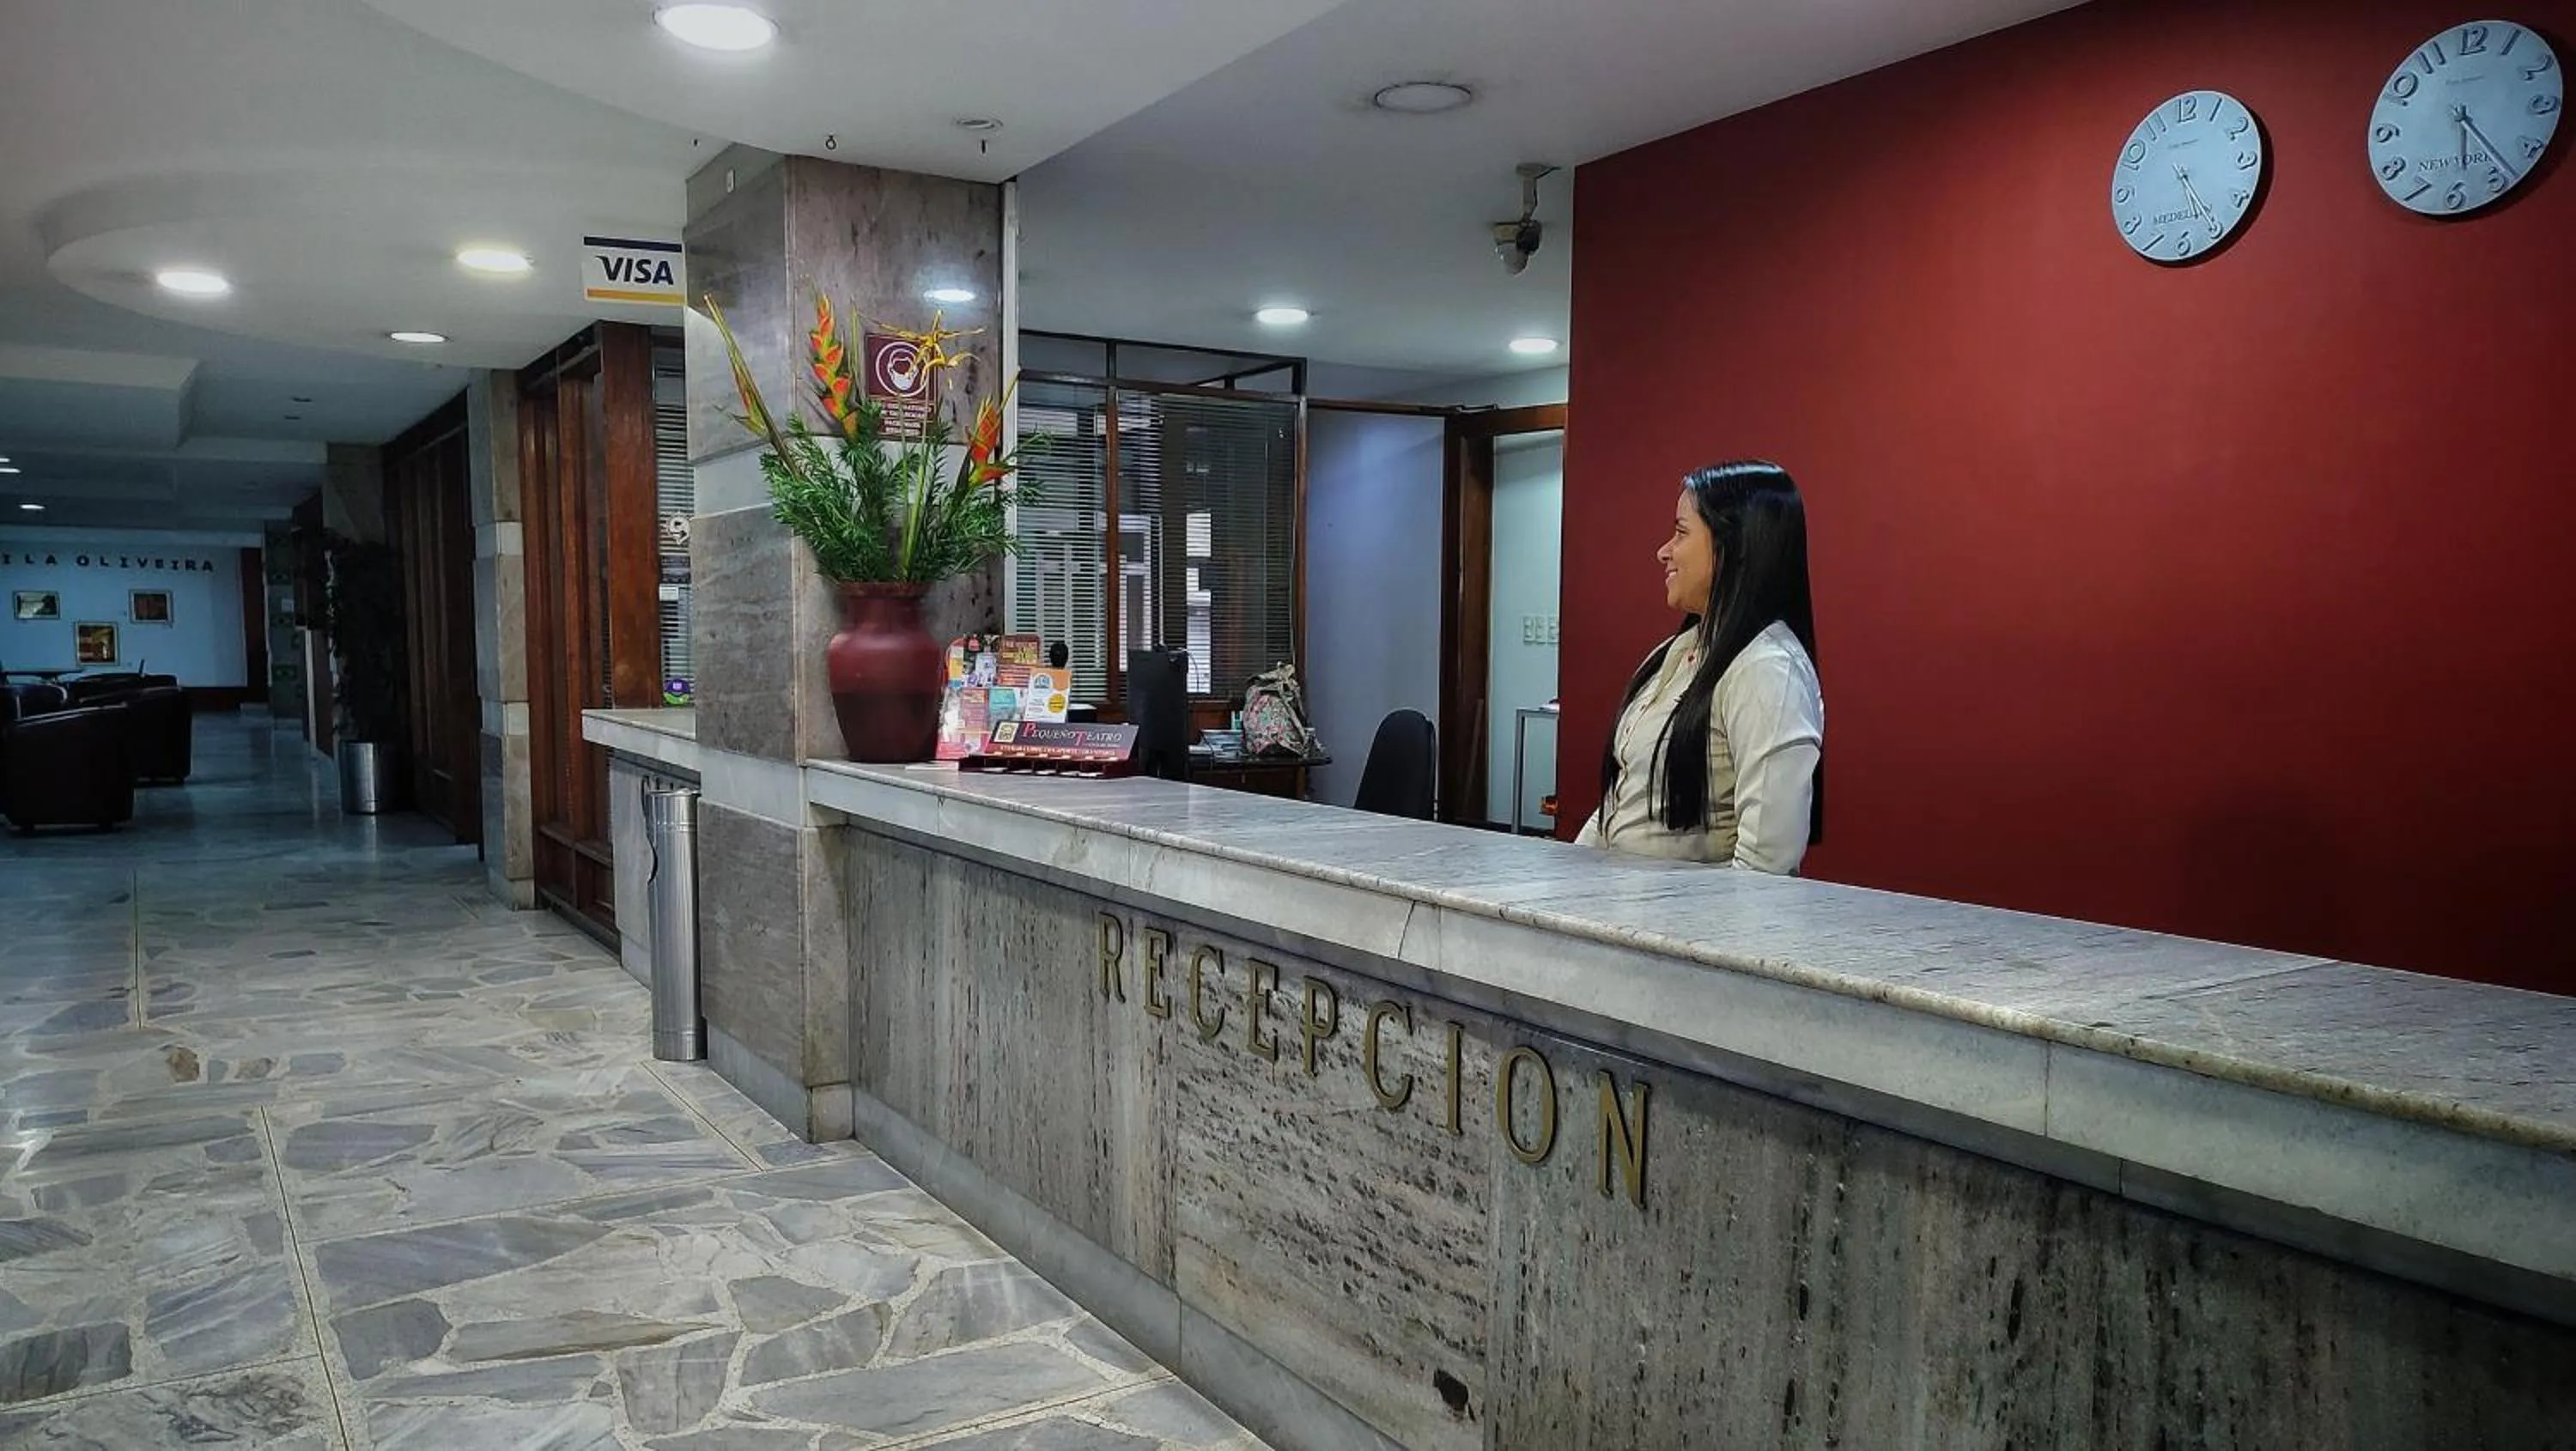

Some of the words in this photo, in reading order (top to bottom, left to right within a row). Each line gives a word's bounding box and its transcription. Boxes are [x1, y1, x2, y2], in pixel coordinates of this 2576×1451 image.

[2459, 26, 2488, 56] 12
[2418, 40, 2446, 74] 11
[2519, 54, 2553, 81] 2
[2386, 71, 2419, 107] 10
[2178, 95, 2197, 123] 12
[2529, 94, 2558, 115] 3
[2147, 112, 2166, 141] 11
[2226, 116, 2249, 141] 2
[2376, 124, 2400, 143] 9
[2122, 139, 2147, 171] 10
[2518, 136, 2543, 158] 4
[2236, 150, 2257, 170] 3
[2383, 156, 2406, 181] 8
[2419, 157, 2451, 171] NEW
[2116, 185, 2136, 203] 9
[2232, 188, 2250, 208] 4
[2447, 181, 2465, 209] 6
[2123, 215, 2142, 235] 8
[2177, 230, 2191, 256] 6
[595, 255, 674, 285] VISA
[75, 554, 215, 572] OLIVEIRA
[1097, 910, 1651, 1210] RECEPCION
